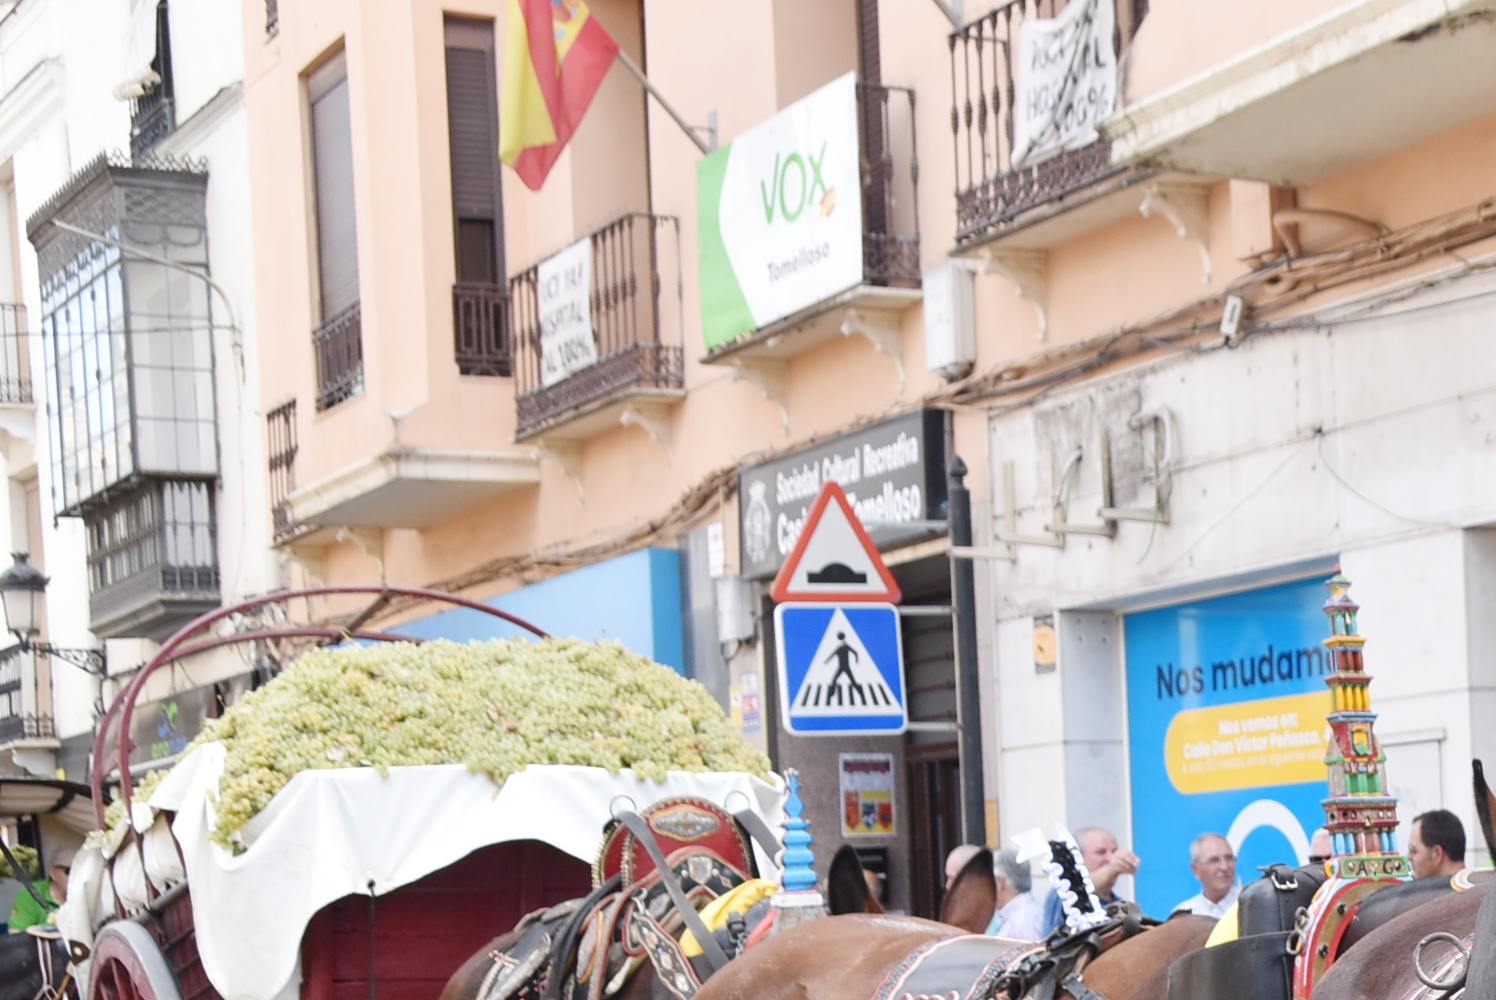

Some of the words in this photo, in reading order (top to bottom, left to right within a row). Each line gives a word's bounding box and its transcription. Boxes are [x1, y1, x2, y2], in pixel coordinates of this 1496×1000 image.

[760, 140, 827, 225] VOX
[767, 242, 830, 283] Tomelloso
[776, 460, 820, 505] Sociedad
[862, 431, 919, 478] Recreativa
[1156, 662, 1204, 700] Nos
